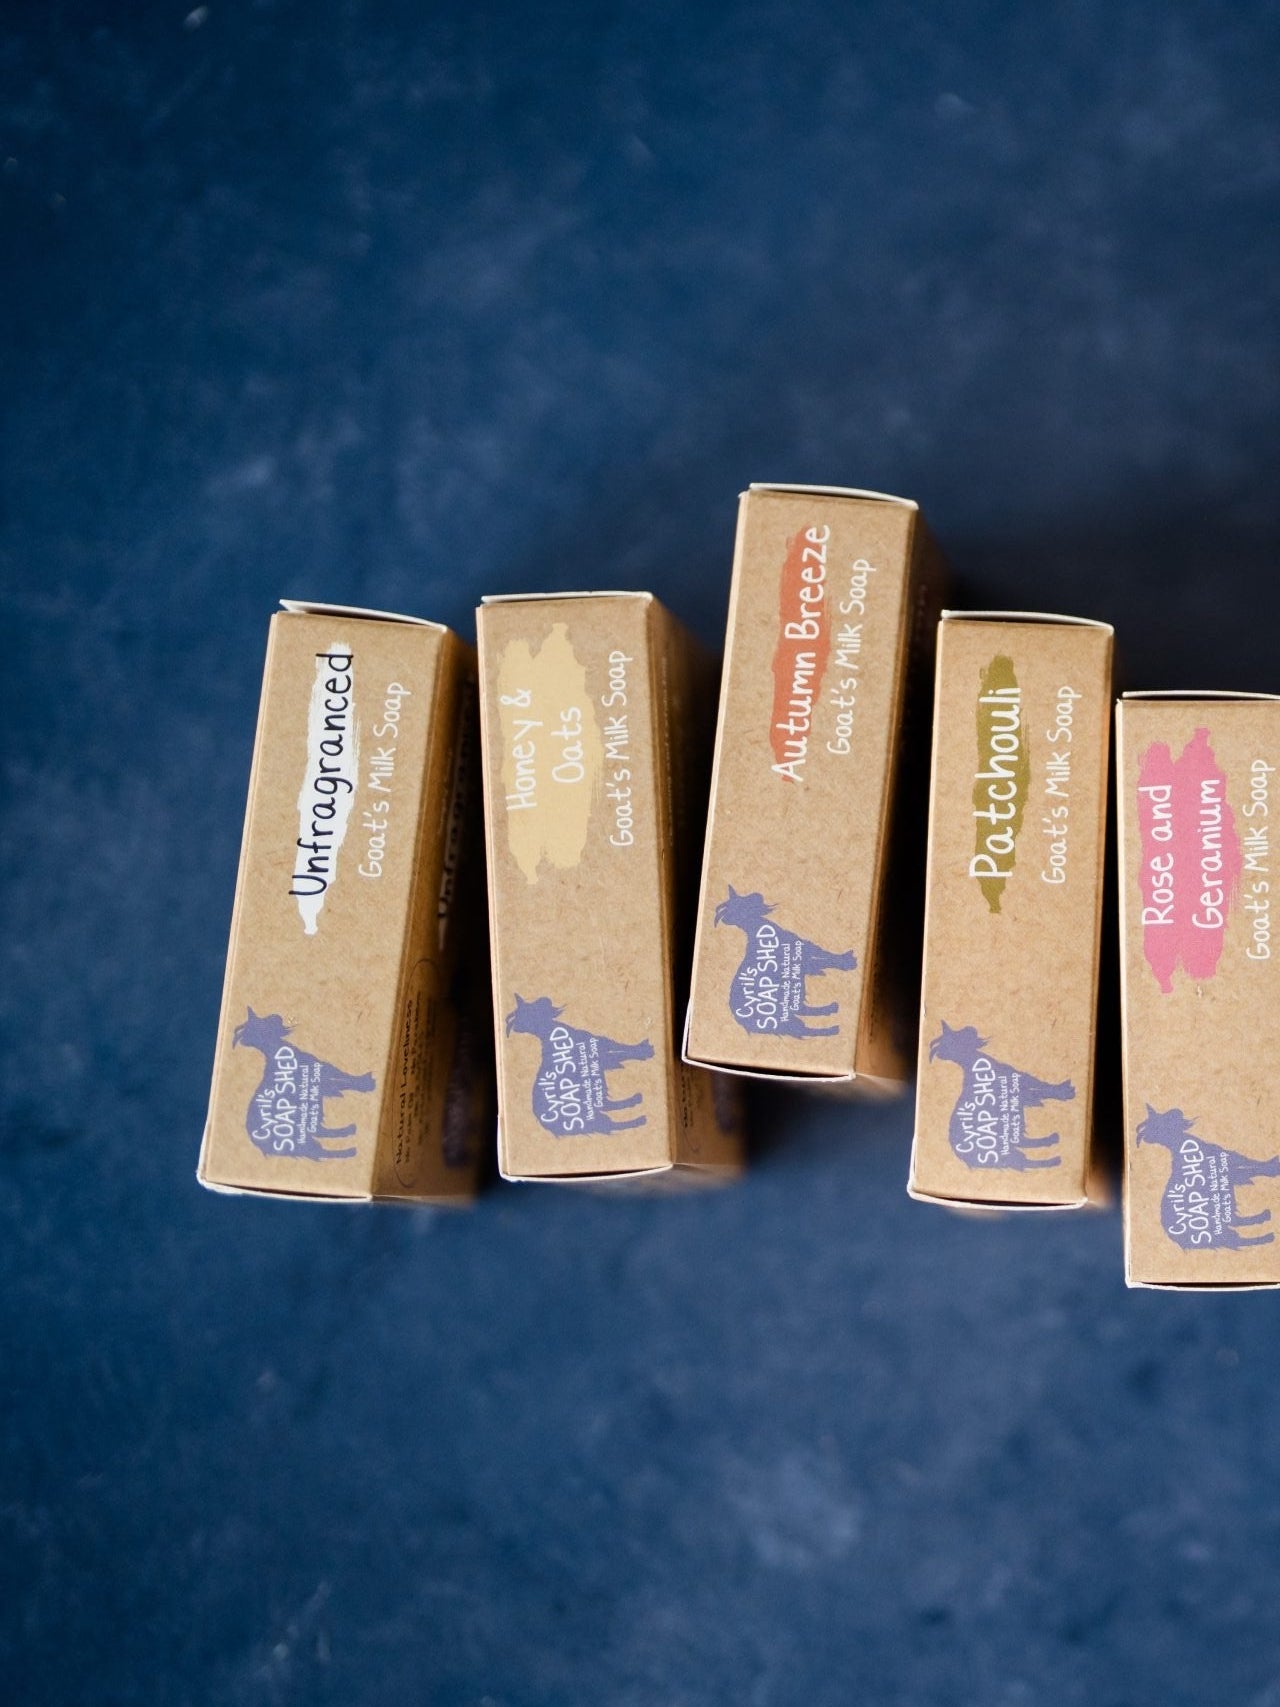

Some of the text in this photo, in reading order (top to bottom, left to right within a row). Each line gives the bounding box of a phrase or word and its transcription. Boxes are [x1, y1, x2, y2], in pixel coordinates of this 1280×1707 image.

[771, 525, 830, 782] Autumn Breeze
[826, 559, 876, 755] Goat's Milk Soap
[288, 653, 354, 896] Unfragranced
[358, 682, 411, 877] Goat's Milk Soap
[500, 688, 543, 810] Honey &
[551, 706, 584, 782] Oats
[602, 651, 634, 846] Goat's Milk Soap
[968, 687, 1021, 877] Patchouli
[1041, 686, 1082, 883] Goat's Milk Soap
[1138, 784, 1174, 926] Rose and
[1192, 779, 1224, 928] Geranium
[1243, 759, 1276, 960] Goat's Milk Soap
[736, 967, 761, 1017] Cyril's
[756, 924, 780, 1029] SOAP SHED
[779, 943, 790, 1021] Handmade Natural
[791, 940, 805, 1010] Goat's Milk Soap
[252, 1088, 278, 1139] Cyril's
[273, 1046, 298, 1151] SOAP SHED
[296, 1065, 309, 1144] Handmade Natural
[308, 1062, 324, 1132] Goat's Milk Soap
[538, 1071, 564, 1122] Cyril's
[550, 1027, 584, 1130] SOAP SHED
[576, 1042, 594, 1120] Handmade Natural
[589, 1038, 603, 1107] Goat's Milk Soap
[971, 1058, 1000, 1164] SOAP SHED
[998, 1076, 1010, 1155] Handmade Natural
[1009, 1072, 1021, 1143] Goat's Milk Soap
[957, 1101, 981, 1153] Cyril's
[1167, 1183, 1193, 1234] Cyril's
[1180, 1139, 1212, 1244] SOAP SHED
[1207, 1156, 1222, 1235] Handmade Natural
[1219, 1152, 1231, 1222] Goat's Milk Soap
